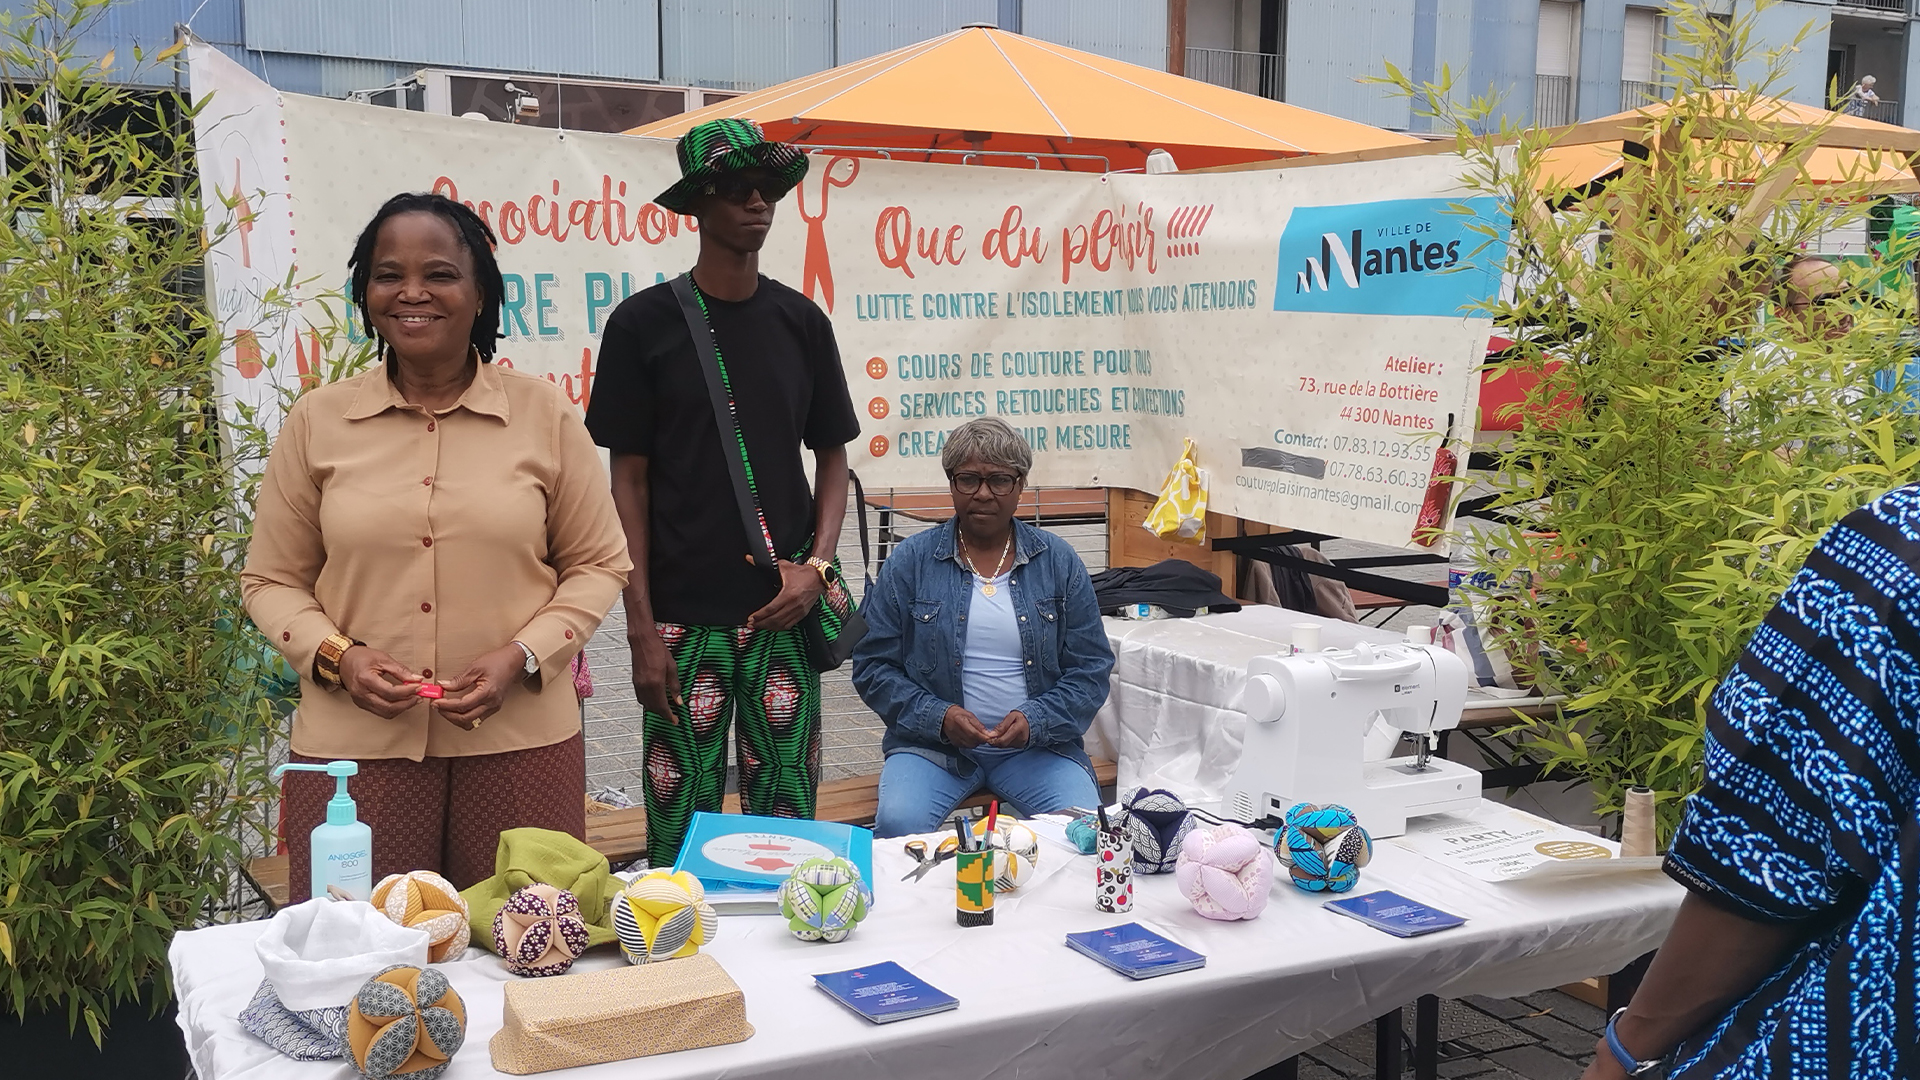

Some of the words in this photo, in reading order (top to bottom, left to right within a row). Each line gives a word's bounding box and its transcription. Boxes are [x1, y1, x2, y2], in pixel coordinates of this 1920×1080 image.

[875, 206, 966, 279] Que
[982, 205, 1049, 268] du
[1062, 201, 1157, 284] plaisir
[1378, 225, 1411, 237] VILLE
[1416, 222, 1432, 234] DE
[1320, 229, 1461, 290] Nantes
[856, 293, 915, 321] LUTTE
[922, 292, 999, 320] CONTRE
[1006, 290, 1126, 321] L'ISOLEMENT,
[1127, 287, 1144, 314] NOUS
[1146, 284, 1178, 312] VOUS
[1182, 279, 1257, 312] ATTENDONS
[898, 353, 962, 380] COURS
[970, 352, 995, 379] DE
[1002, 350, 1085, 378] COUTURE
[1094, 349, 1132, 376] POUR
[1134, 349, 1152, 376] TOUS
[1384, 356, 1435, 376] Atelier
[900, 390, 987, 420] SERVICES
[996, 387, 1102, 416] RETOUCHES
[1111, 386, 1130, 413] ET
[1132, 387, 1185, 417] CONFECTIONS
[1299, 377, 1320, 395] 73,
[1324, 381, 1347, 396] rue
[1349, 380, 1363, 396] de
[1365, 381, 1375, 397] la
[1379, 382, 1439, 403] Bottière
[1354, 407, 1380, 424] 300
[1382, 409, 1434, 430] Nantes
[1016, 425, 1049, 452] UR
[1056, 424, 1132, 450] MESURE
[1274, 428, 1323, 449] Contact
[1333, 435, 1431, 462] 07.83.12.93.55
[1329, 460, 1427, 489] 07.78.63.60.33
[1235, 474, 1423, 516] coutureplaisirnantes@gmail.com
[1442, 829, 1514, 846] PARTY
[341, 859, 358, 868] 800
[1667, 859, 1713, 892] HITARGET
